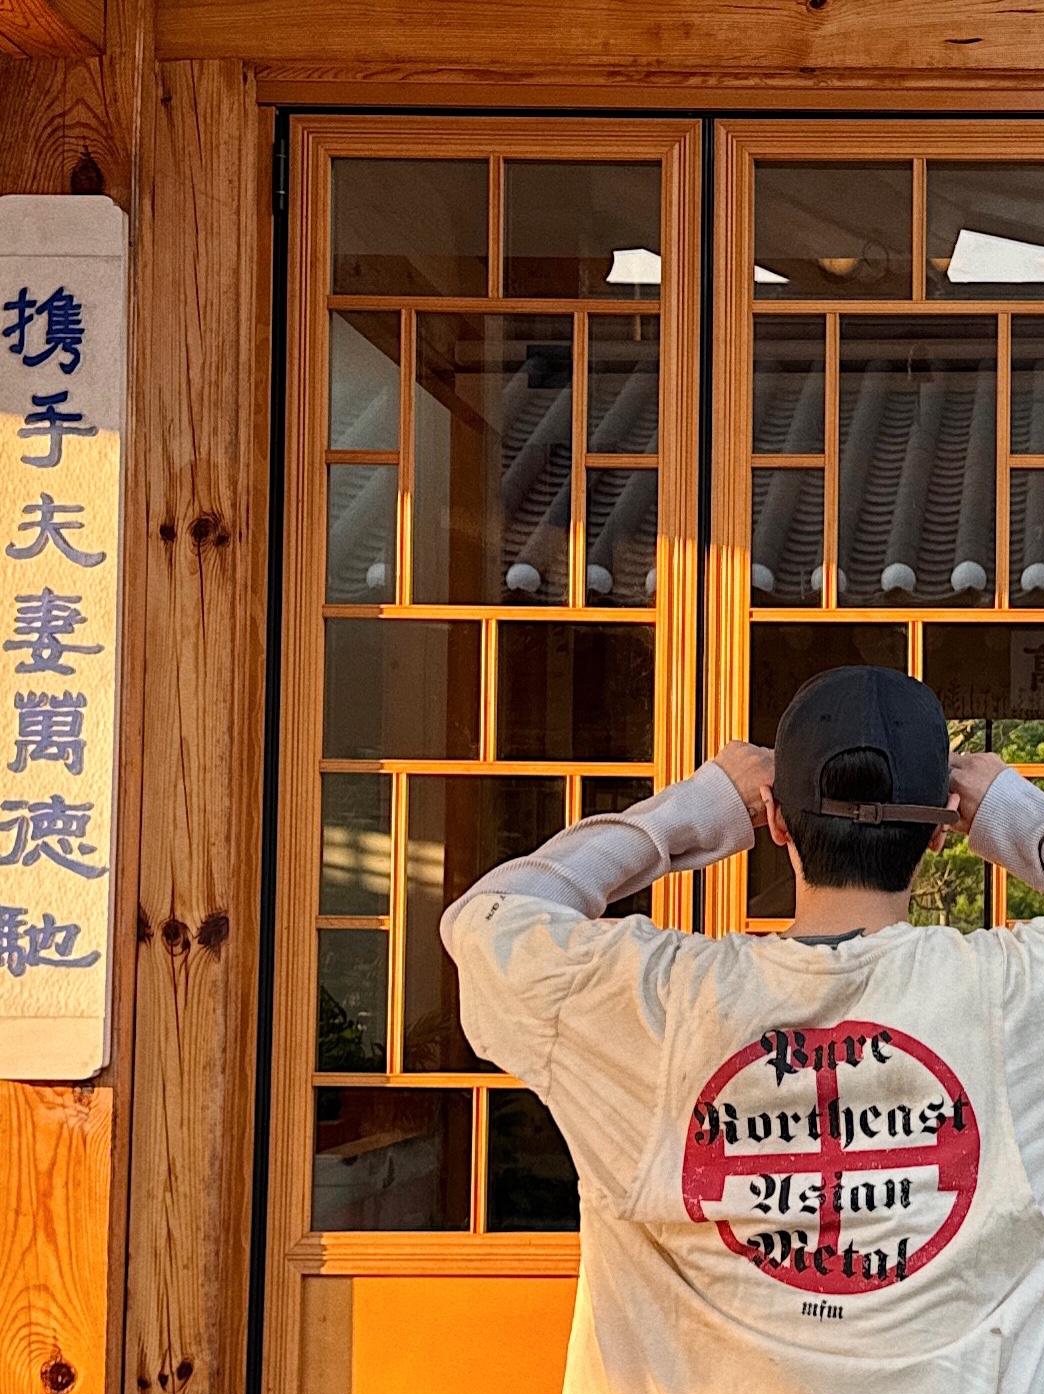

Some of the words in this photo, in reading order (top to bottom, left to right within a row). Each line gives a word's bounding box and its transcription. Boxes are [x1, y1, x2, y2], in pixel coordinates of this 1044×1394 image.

[760, 1029, 893, 1087] Pure
[693, 1094, 969, 1149] Northeast
[749, 1171, 913, 1214] Asian
[746, 1229, 911, 1282] Metal
